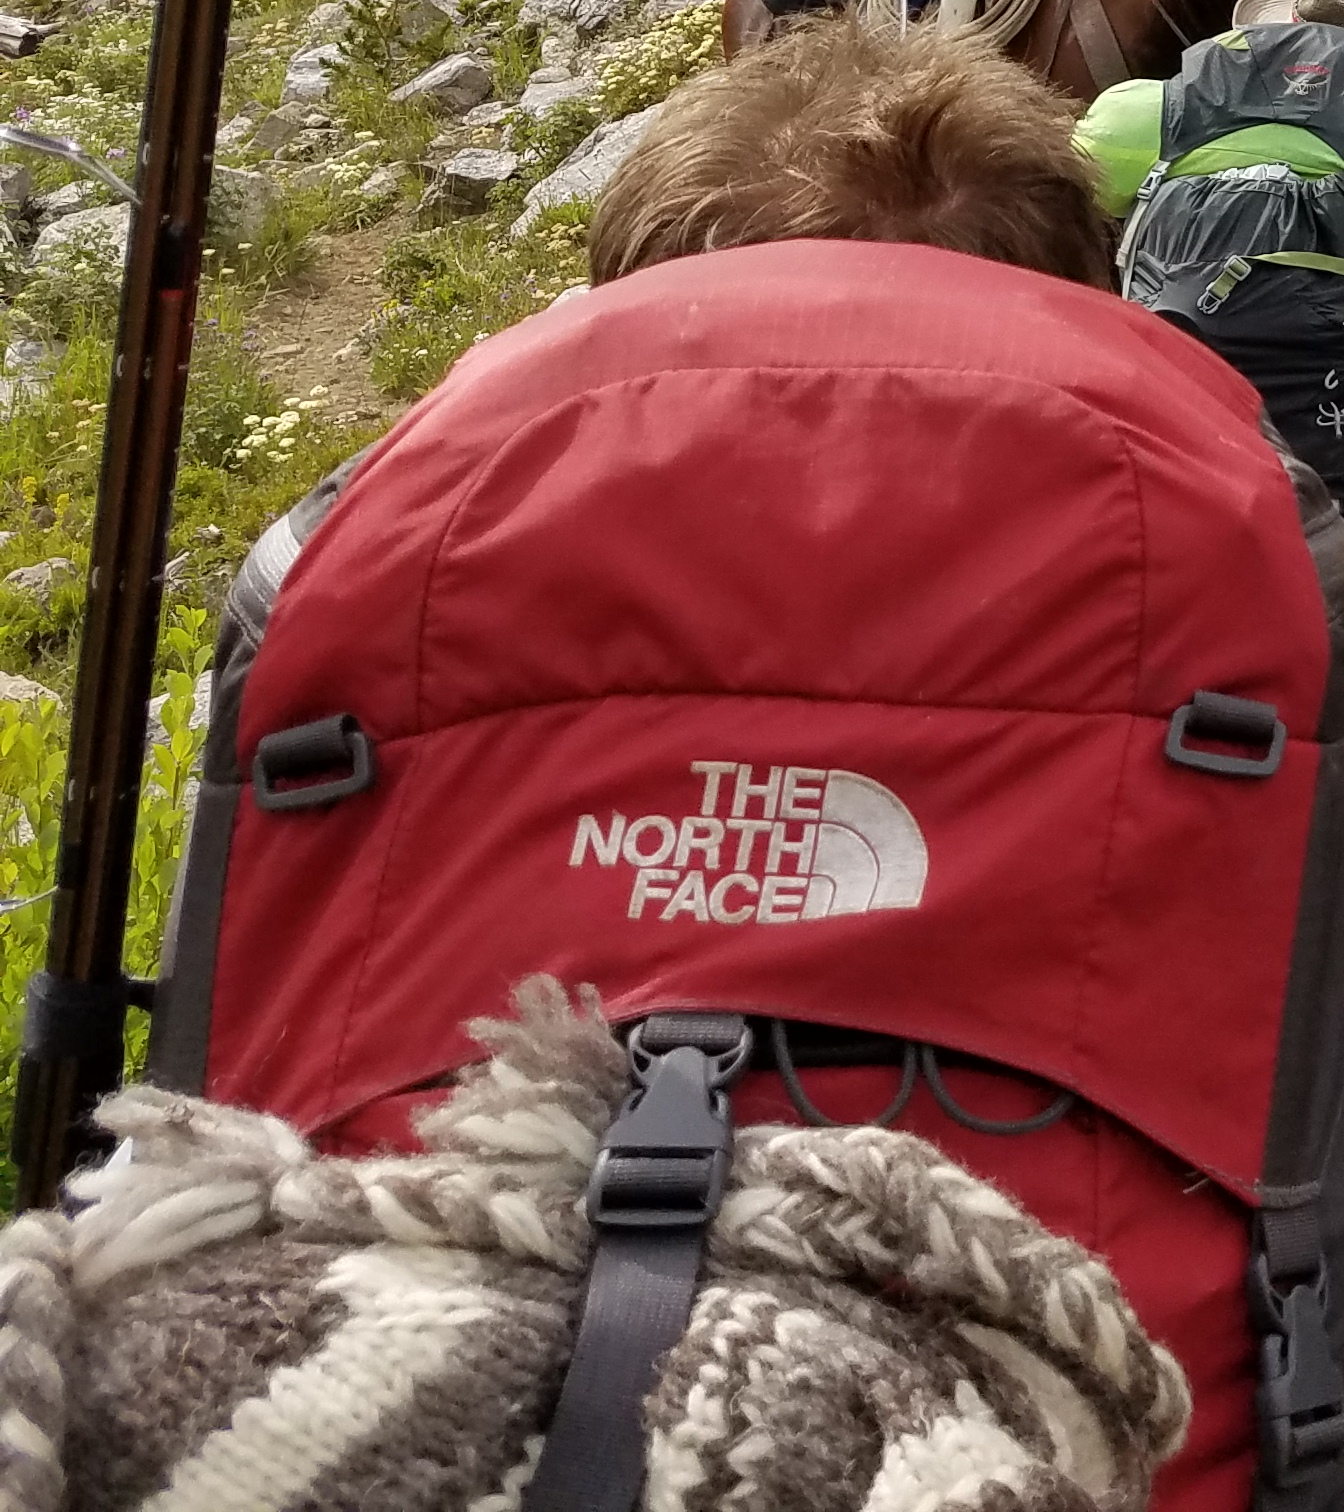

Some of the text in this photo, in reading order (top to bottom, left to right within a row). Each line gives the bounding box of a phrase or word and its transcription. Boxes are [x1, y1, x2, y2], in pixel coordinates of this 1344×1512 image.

[690, 760, 828, 819] THE
[569, 810, 818, 876] NORTH
[627, 868, 808, 924] FACE
